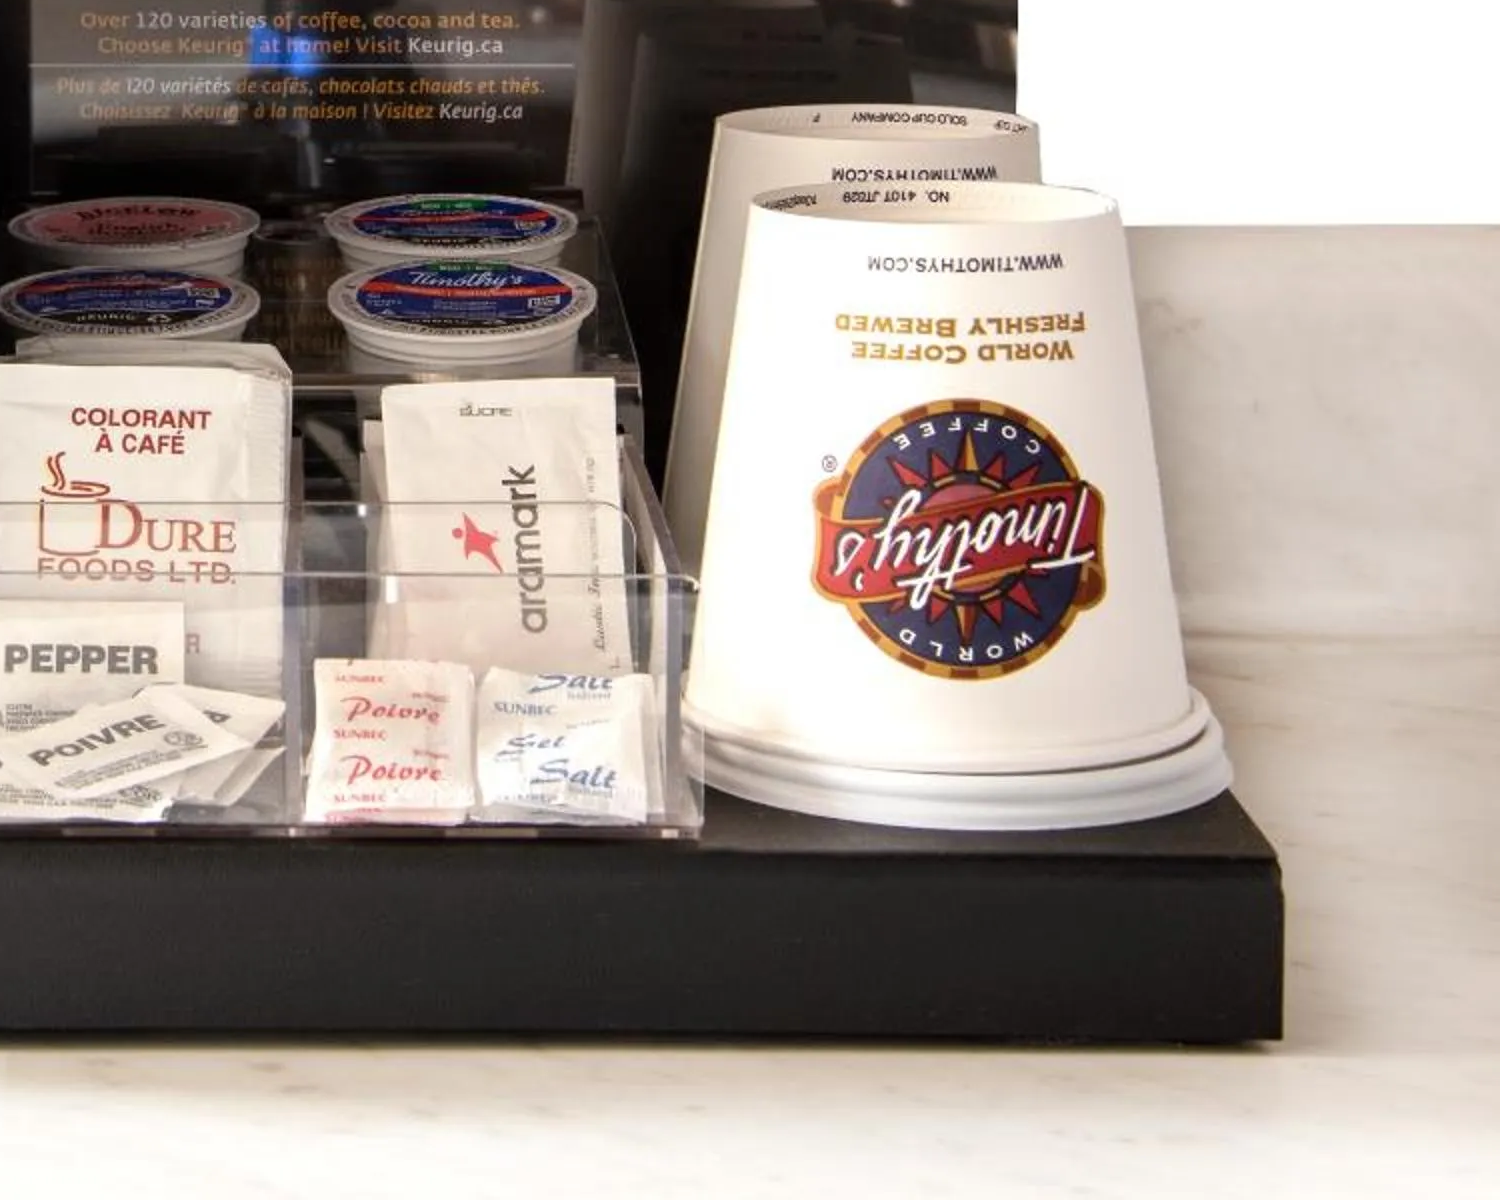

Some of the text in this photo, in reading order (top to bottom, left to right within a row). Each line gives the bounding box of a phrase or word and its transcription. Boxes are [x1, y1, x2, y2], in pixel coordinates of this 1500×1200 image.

[80, 11, 521, 32] Over 120 varieties of coffee, cocoa and tea.
[99, 37, 173, 54] Choose
[259, 39, 281, 54] at
[286, 36, 350, 54] home!
[354, 36, 402, 54] Visit
[408, 37, 504, 59] Keurig.ca
[57, 76, 545, 98] Plus de 120 variétés de cafés, chocolats chauds et thés.
[79, 103, 171, 120] Choisissez
[269, 102, 286, 119] la
[291, 104, 357, 119] maison
[372, 102, 434, 119] Visitez
[439, 102, 523, 123] Keurig.ca
[851, 111, 911, 125] COMPANY
[937, 114, 968, 126] SOLO
[831, 166, 998, 182] WWW.TIMOTHYS.COM
[926, 190, 950, 203] NO.
[867, 254, 1064, 273] WWW.TIMOTHYS.COM
[408, 271, 524, 290] Timothy's
[835, 312, 1087, 339] FRESHLY BREWED
[851, 341, 1074, 365] WORLD COFFEE
[71, 407, 211, 430] COLORANT
[95, 428, 185, 455] À CAFÉ
[893, 417, 1042, 454] COFFEE
[502, 464, 548, 634] aramark
[834, 486, 1096, 610] Timothy's
[38, 557, 237, 585] FOODS LTD.
[898, 628, 1034, 662] WORLD
[3, 643, 159, 675] PEPPER
[340, 696, 441, 724] Poivre
[494, 701, 557, 716] SUNBEC
[28, 714, 167, 766] POIVRE
[497, 733, 565, 756] Sel
[340, 755, 442, 786] Poivre
[530, 758, 617, 789] Salt
